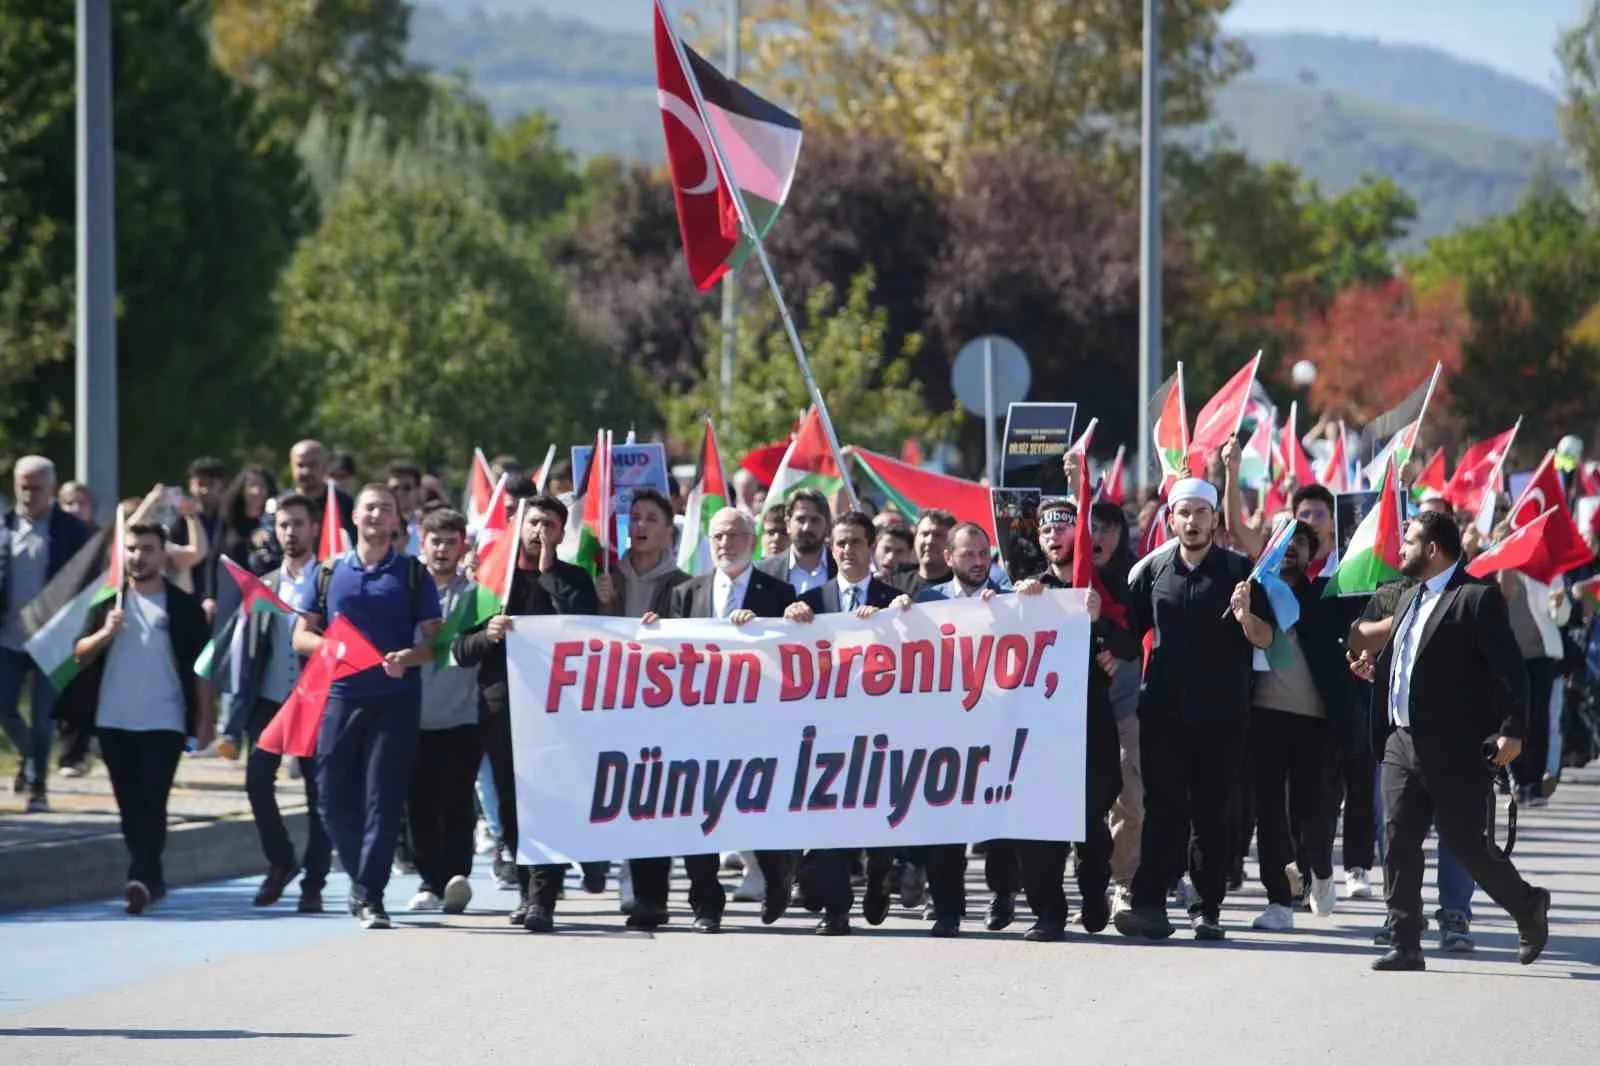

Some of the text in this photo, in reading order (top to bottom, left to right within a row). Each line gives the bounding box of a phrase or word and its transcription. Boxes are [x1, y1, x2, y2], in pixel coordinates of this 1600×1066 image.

[545, 624, 1058, 713] Filistin Direniyor,
[589, 746, 778, 836] Dünya
